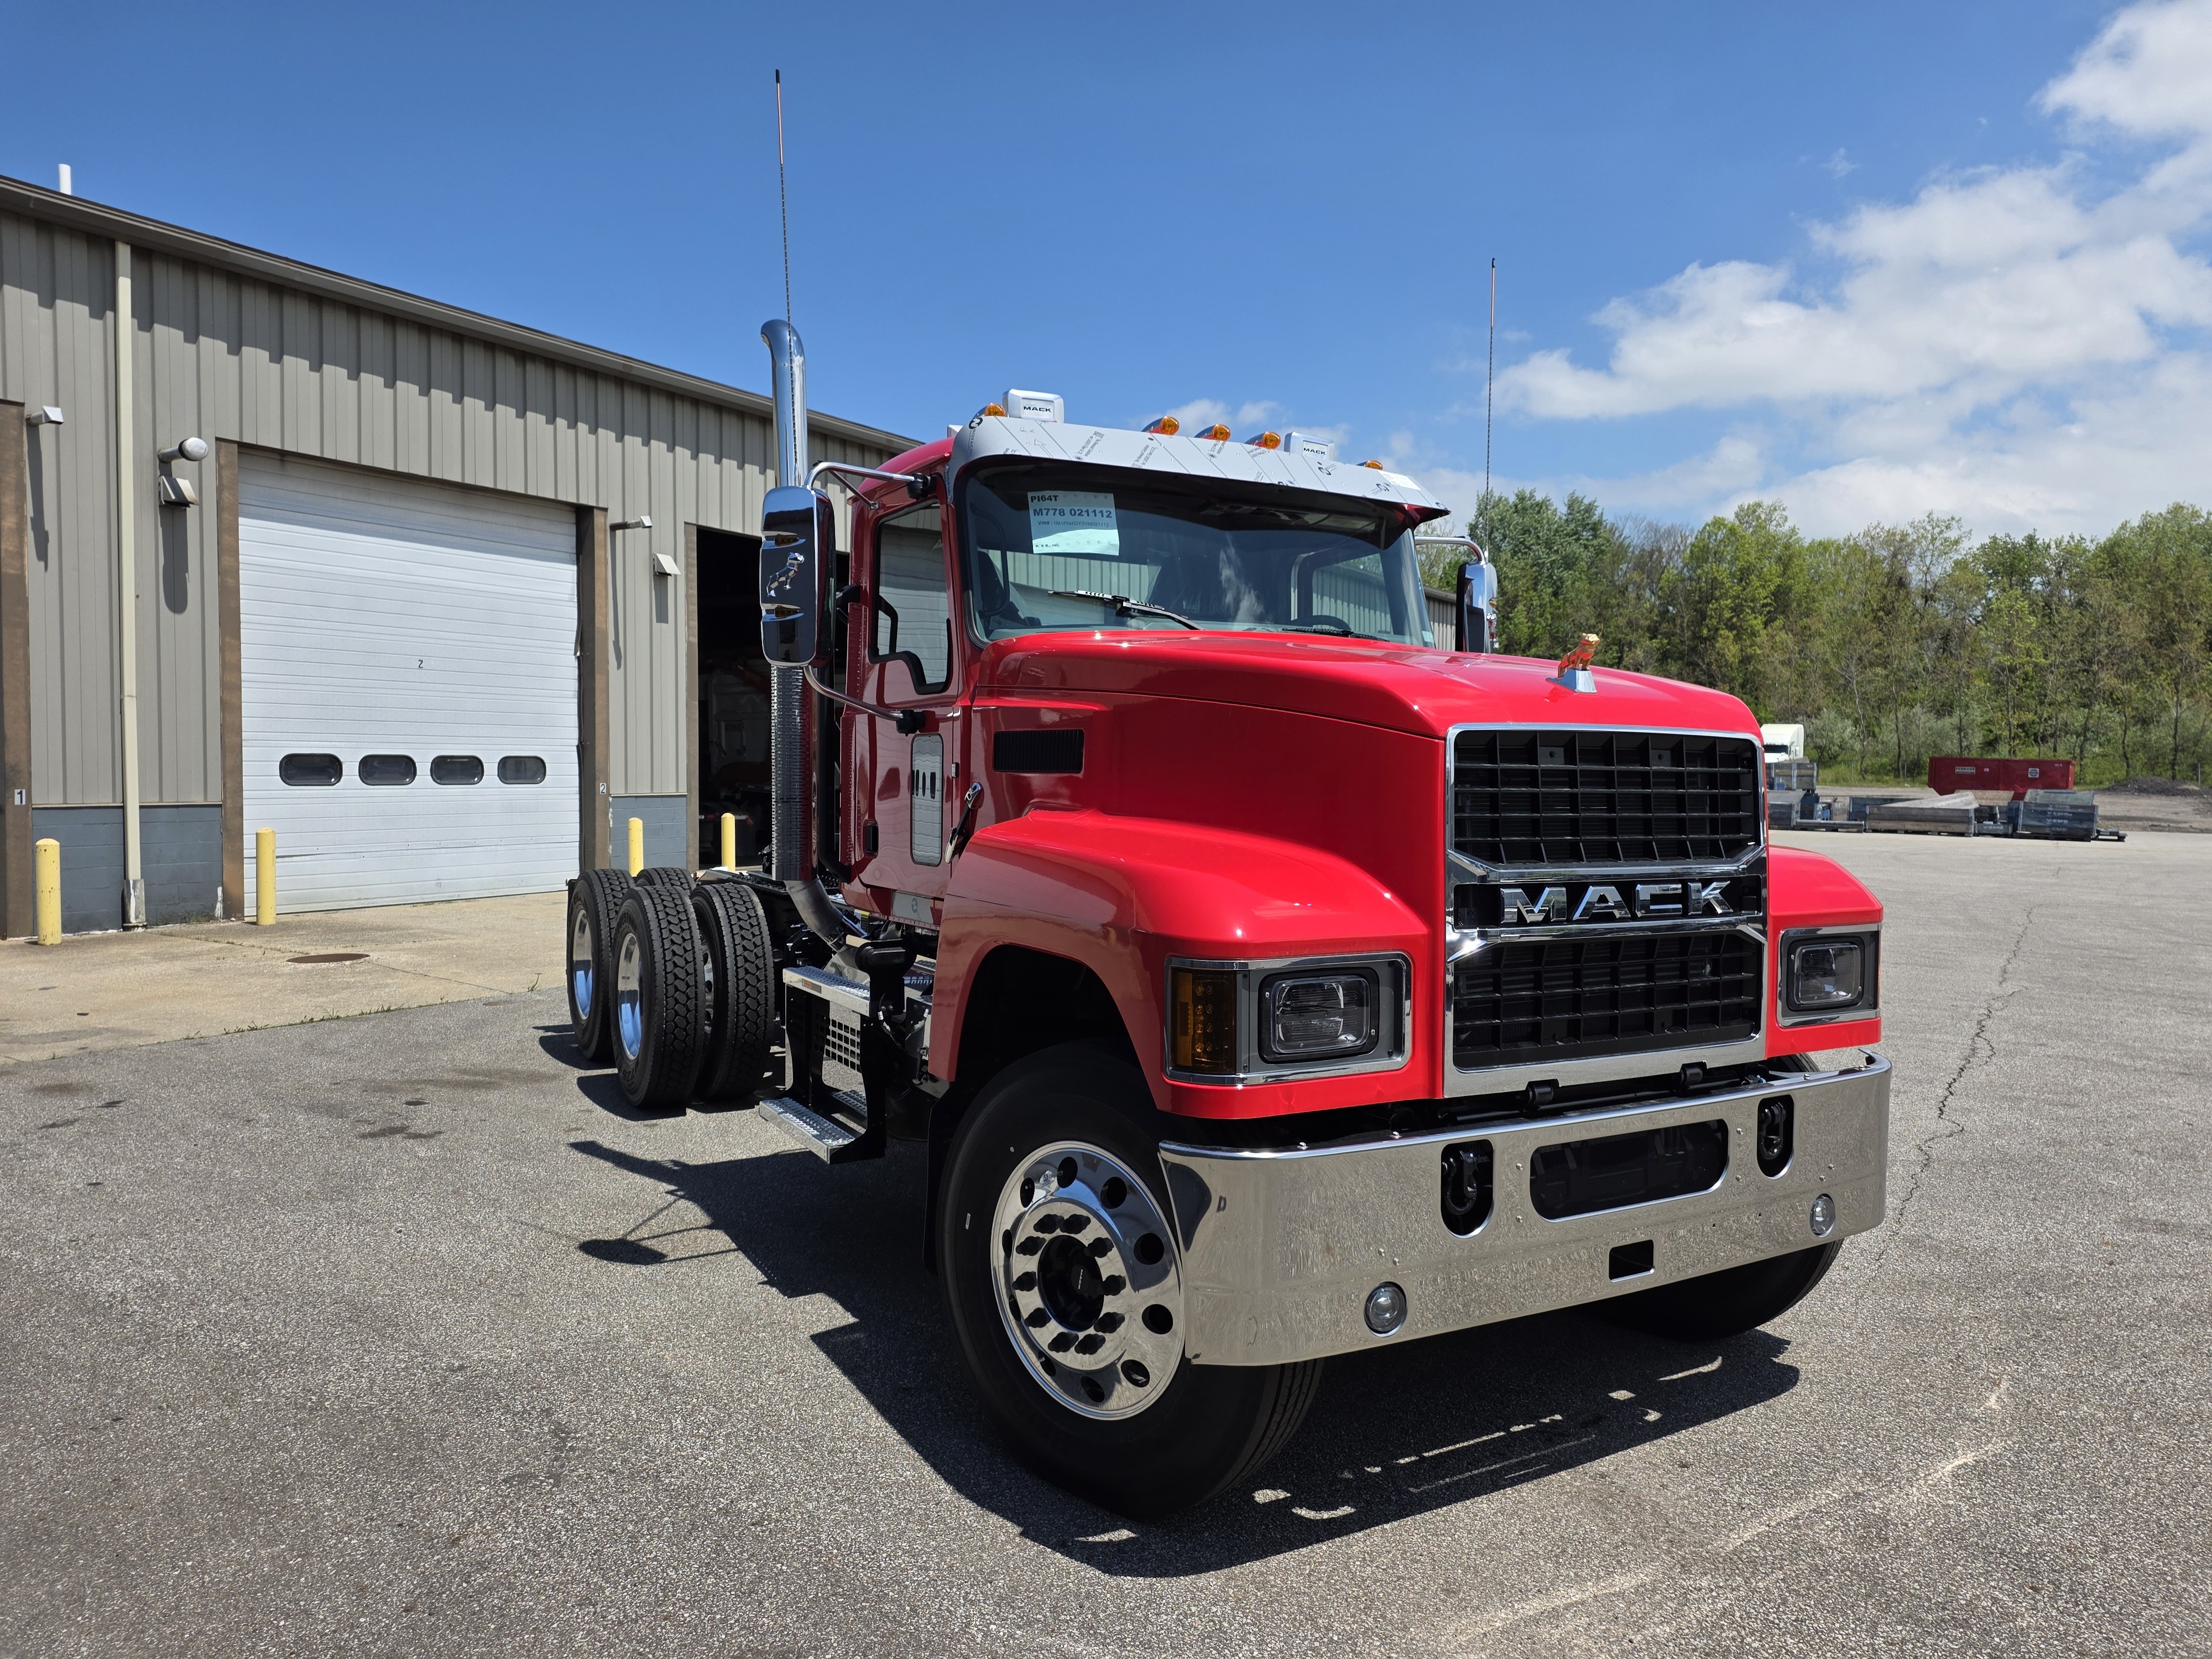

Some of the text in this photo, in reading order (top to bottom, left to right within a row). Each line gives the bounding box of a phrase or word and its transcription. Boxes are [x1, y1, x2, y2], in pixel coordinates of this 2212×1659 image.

[1033, 508, 1113, 518] M778 021112
[418, 659, 424, 669] 2
[601, 783, 606, 794] 2
[17, 789, 23, 805] 1
[1500, 880, 1734, 924] MACK
